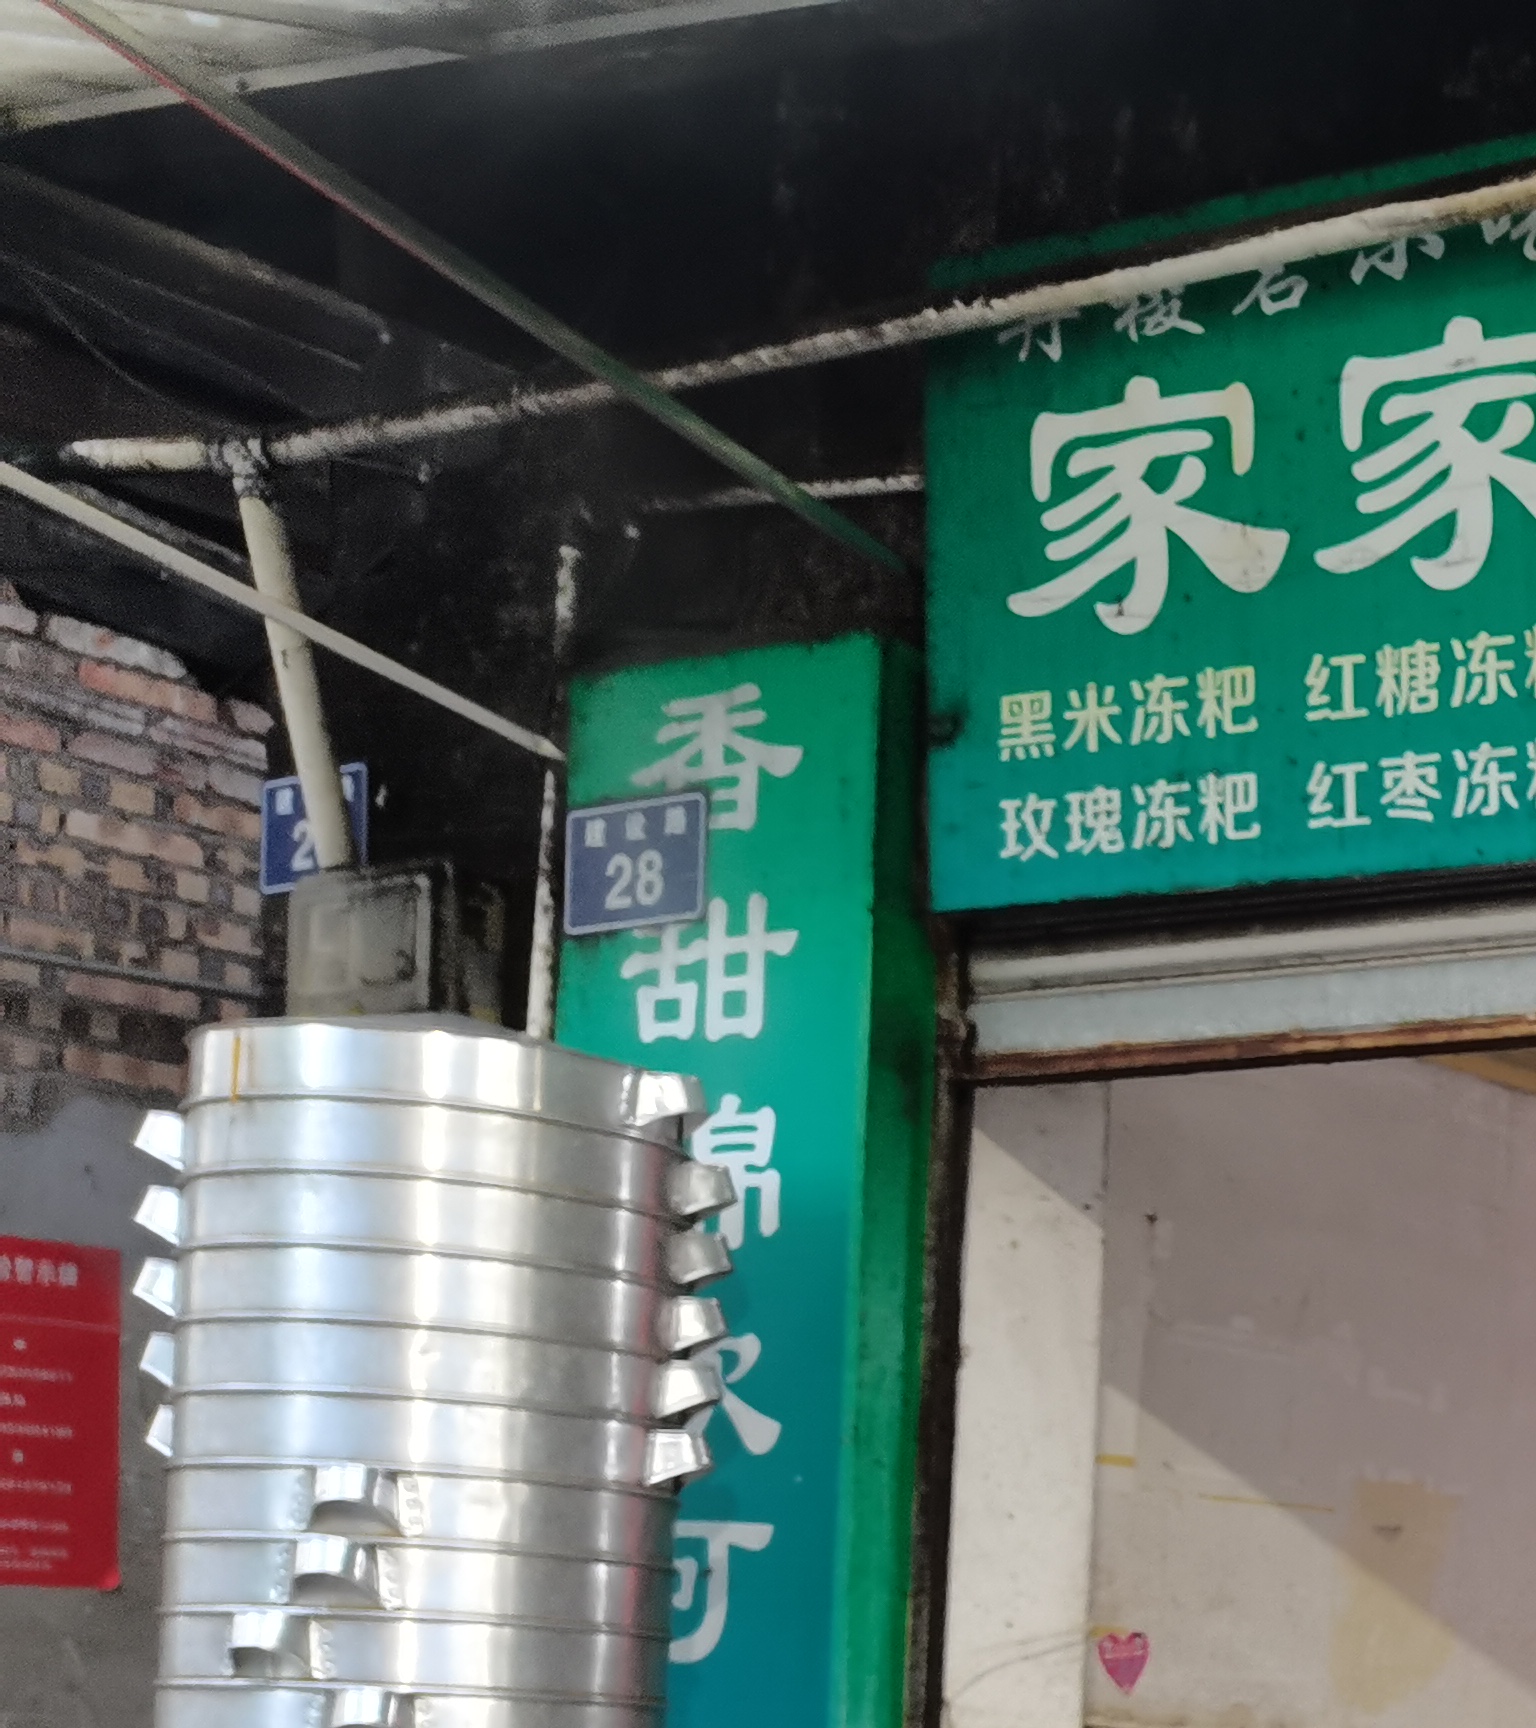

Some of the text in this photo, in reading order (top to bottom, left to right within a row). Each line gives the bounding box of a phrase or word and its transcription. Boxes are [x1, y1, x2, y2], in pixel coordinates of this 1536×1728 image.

[998, 666, 1259, 762] 黑米冻粑
[998, 772, 1261, 863] 玫瑰冻粑
[605, 849, 664, 911] 28
